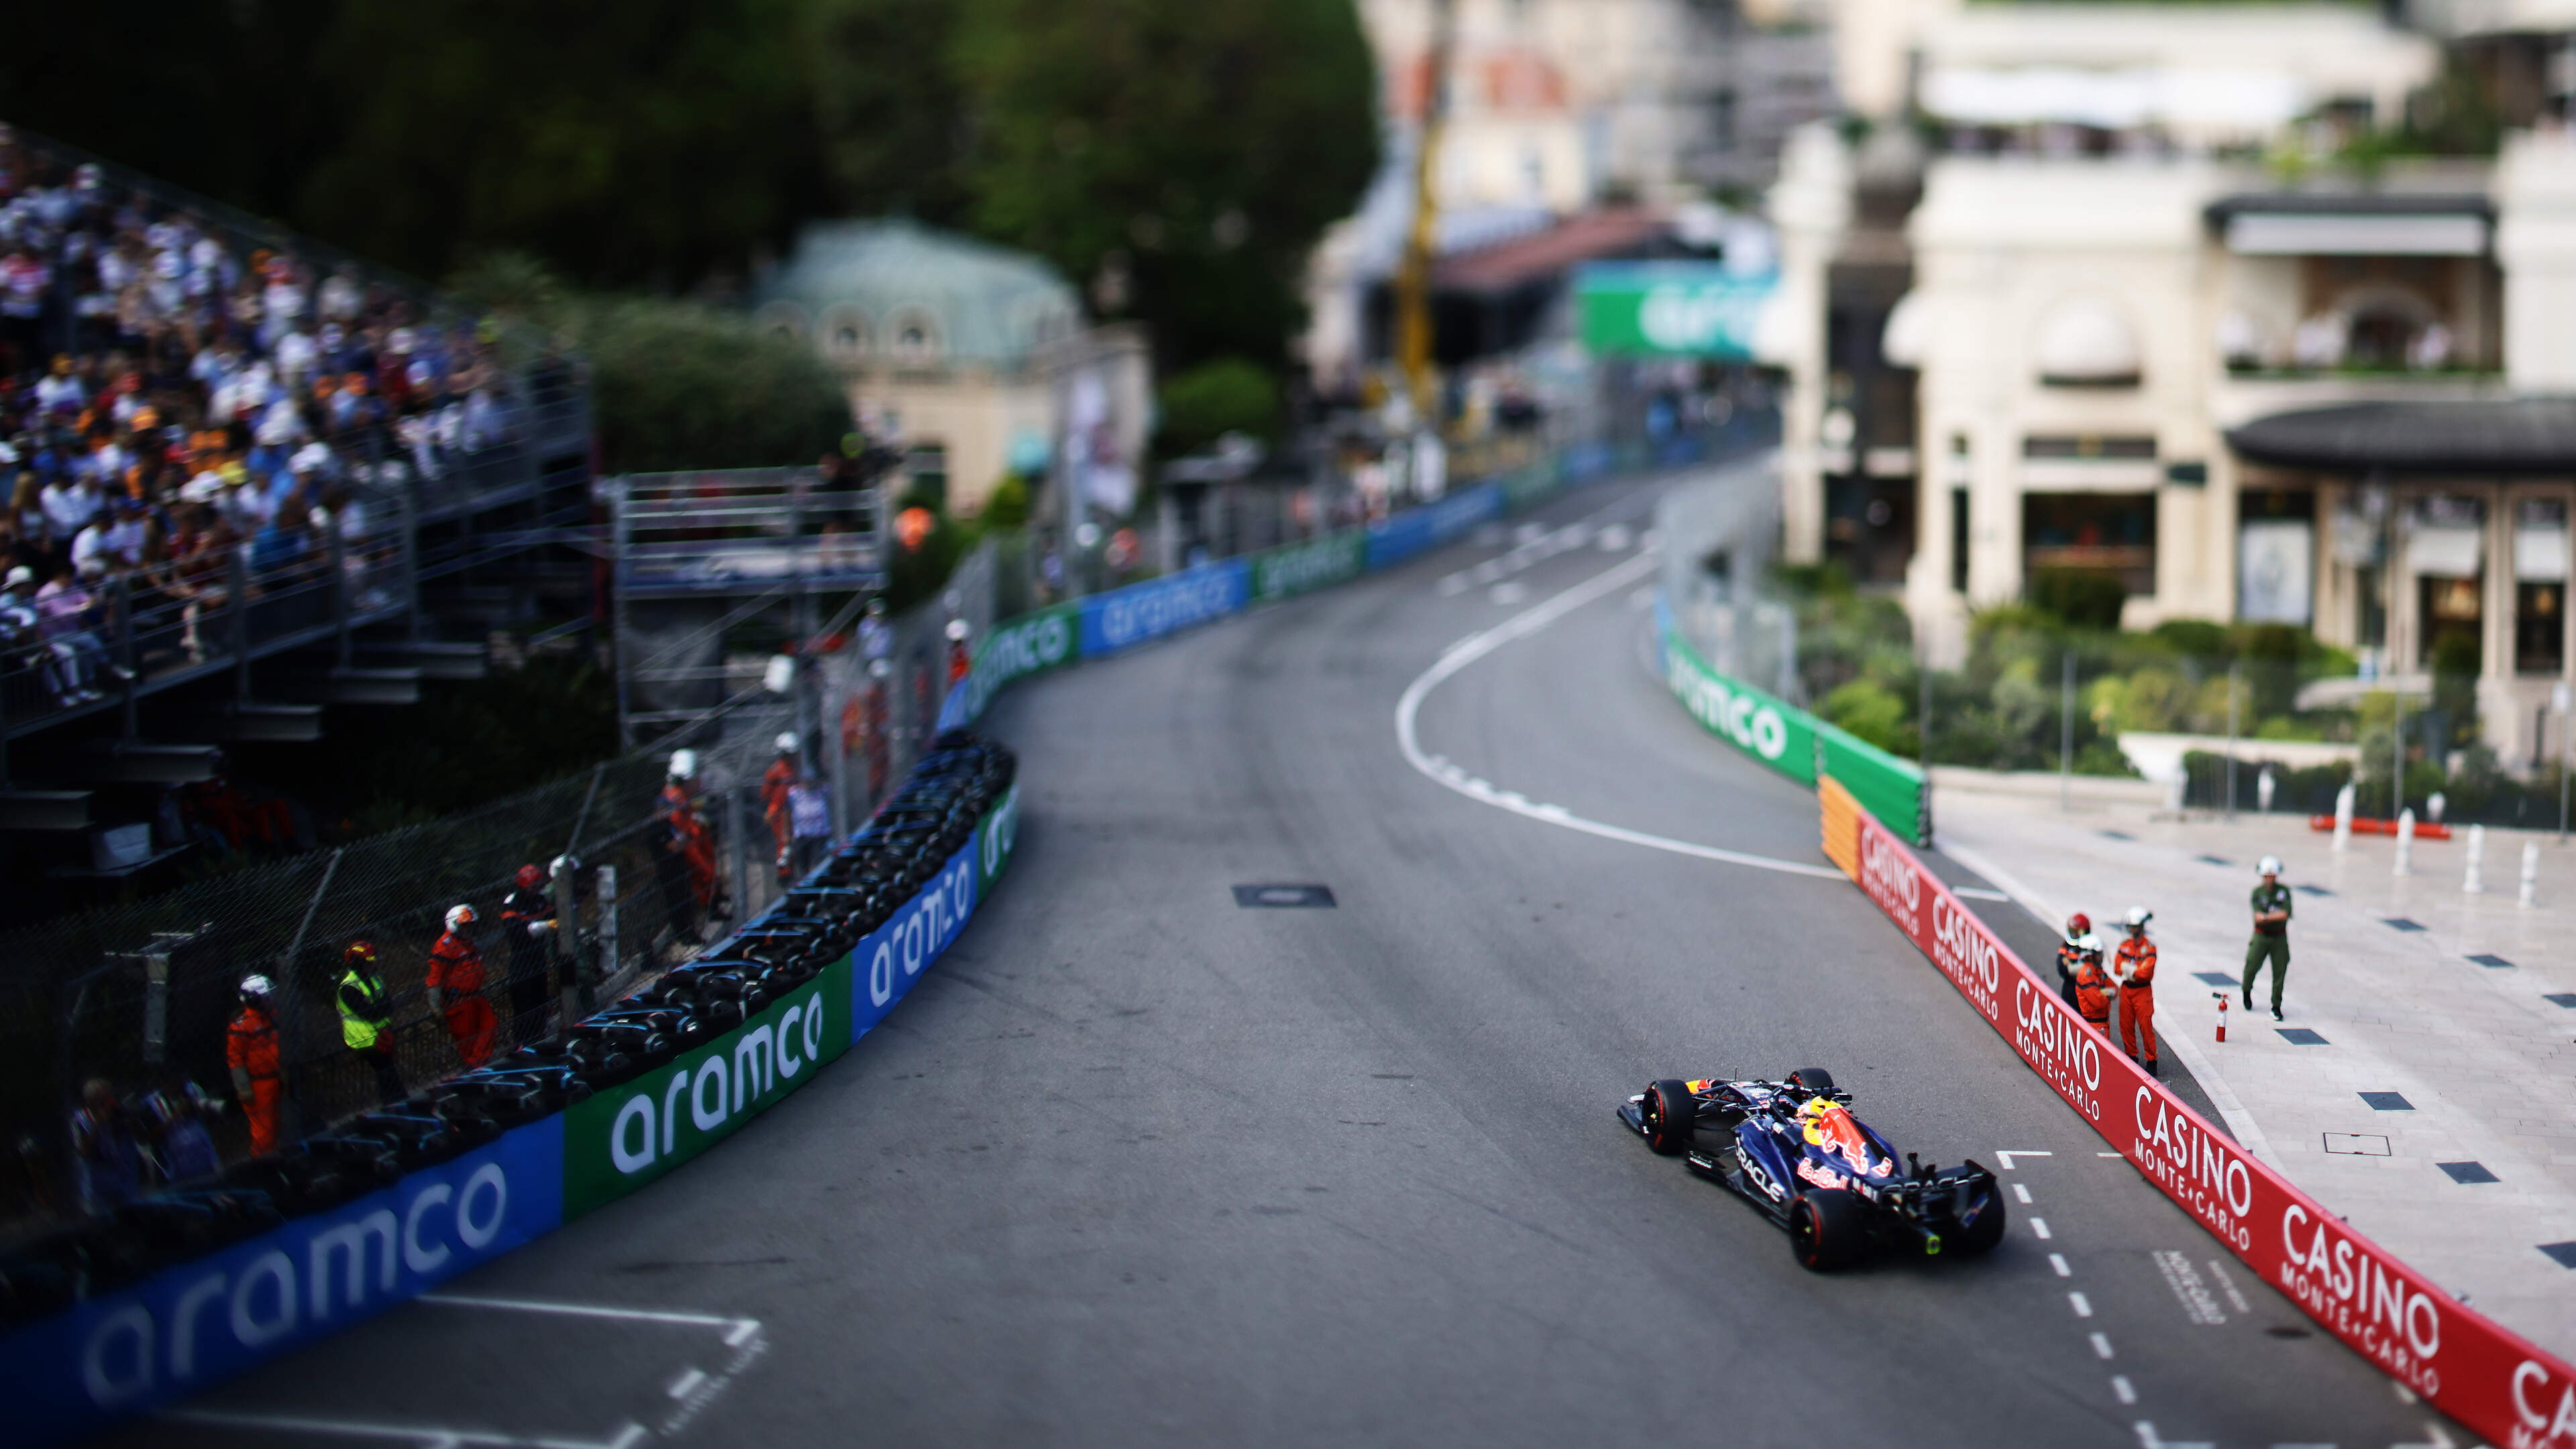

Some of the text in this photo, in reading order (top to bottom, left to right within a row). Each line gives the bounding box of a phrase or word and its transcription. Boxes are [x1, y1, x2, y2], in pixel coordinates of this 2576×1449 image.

[870, 859, 969, 1008] aramco
[1933, 895, 1999, 994] CASINO
[611, 991, 822, 1174] aramco
[2017, 977, 2100, 1091] CASINO
[2017, 1026, 2100, 1121] MONTE CARLO
[1735, 1136, 1784, 1202] ORACLE
[2135, 1085, 2251, 1217] CASINO
[2135, 1138, 2250, 1250] MONTE CARLO
[82, 1163, 506, 1413] aramco
[2282, 1260, 2350, 1334] MONTE
[2363, 1326, 2440, 1397] CARLO
[2284, 1204, 2439, 1359] CASINO
